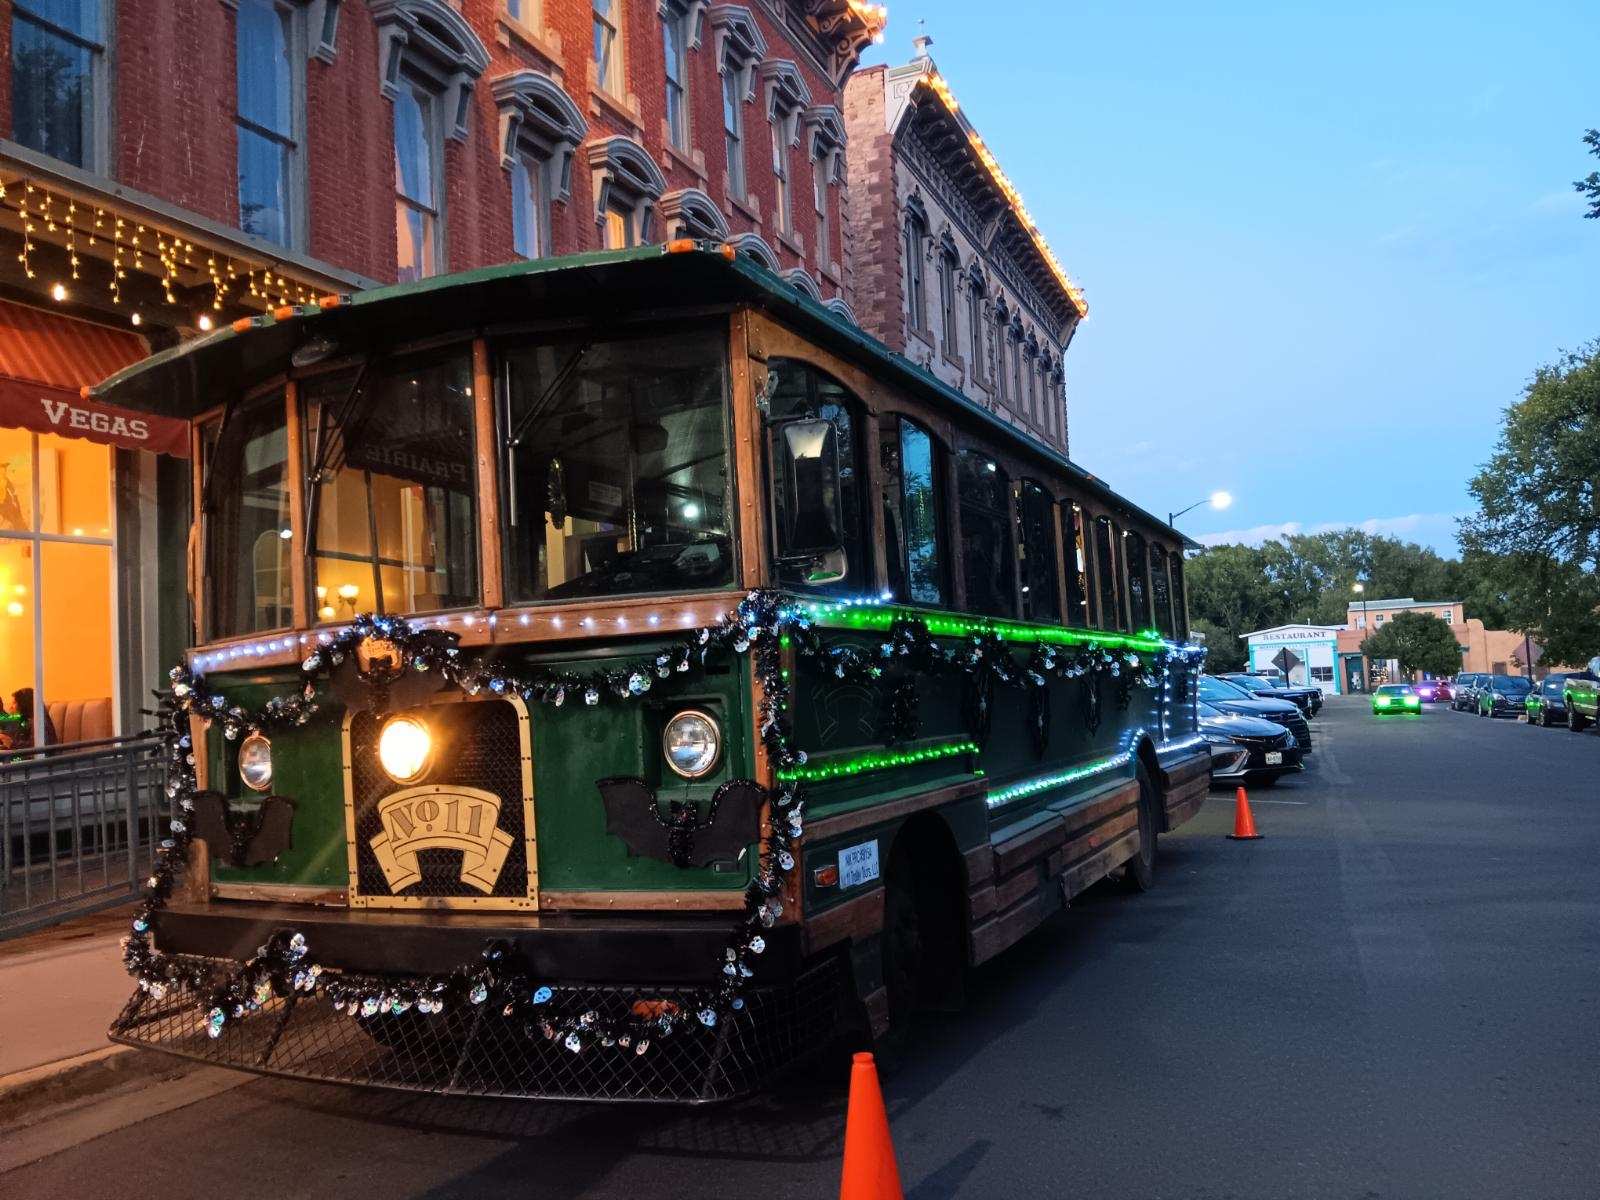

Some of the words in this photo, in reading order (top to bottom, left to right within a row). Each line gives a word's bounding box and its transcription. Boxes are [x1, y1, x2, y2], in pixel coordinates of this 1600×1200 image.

[41, 399, 149, 440] VEGAS
[1263, 631, 1327, 641] RESTAURANT
[444, 799, 483, 839] 11
